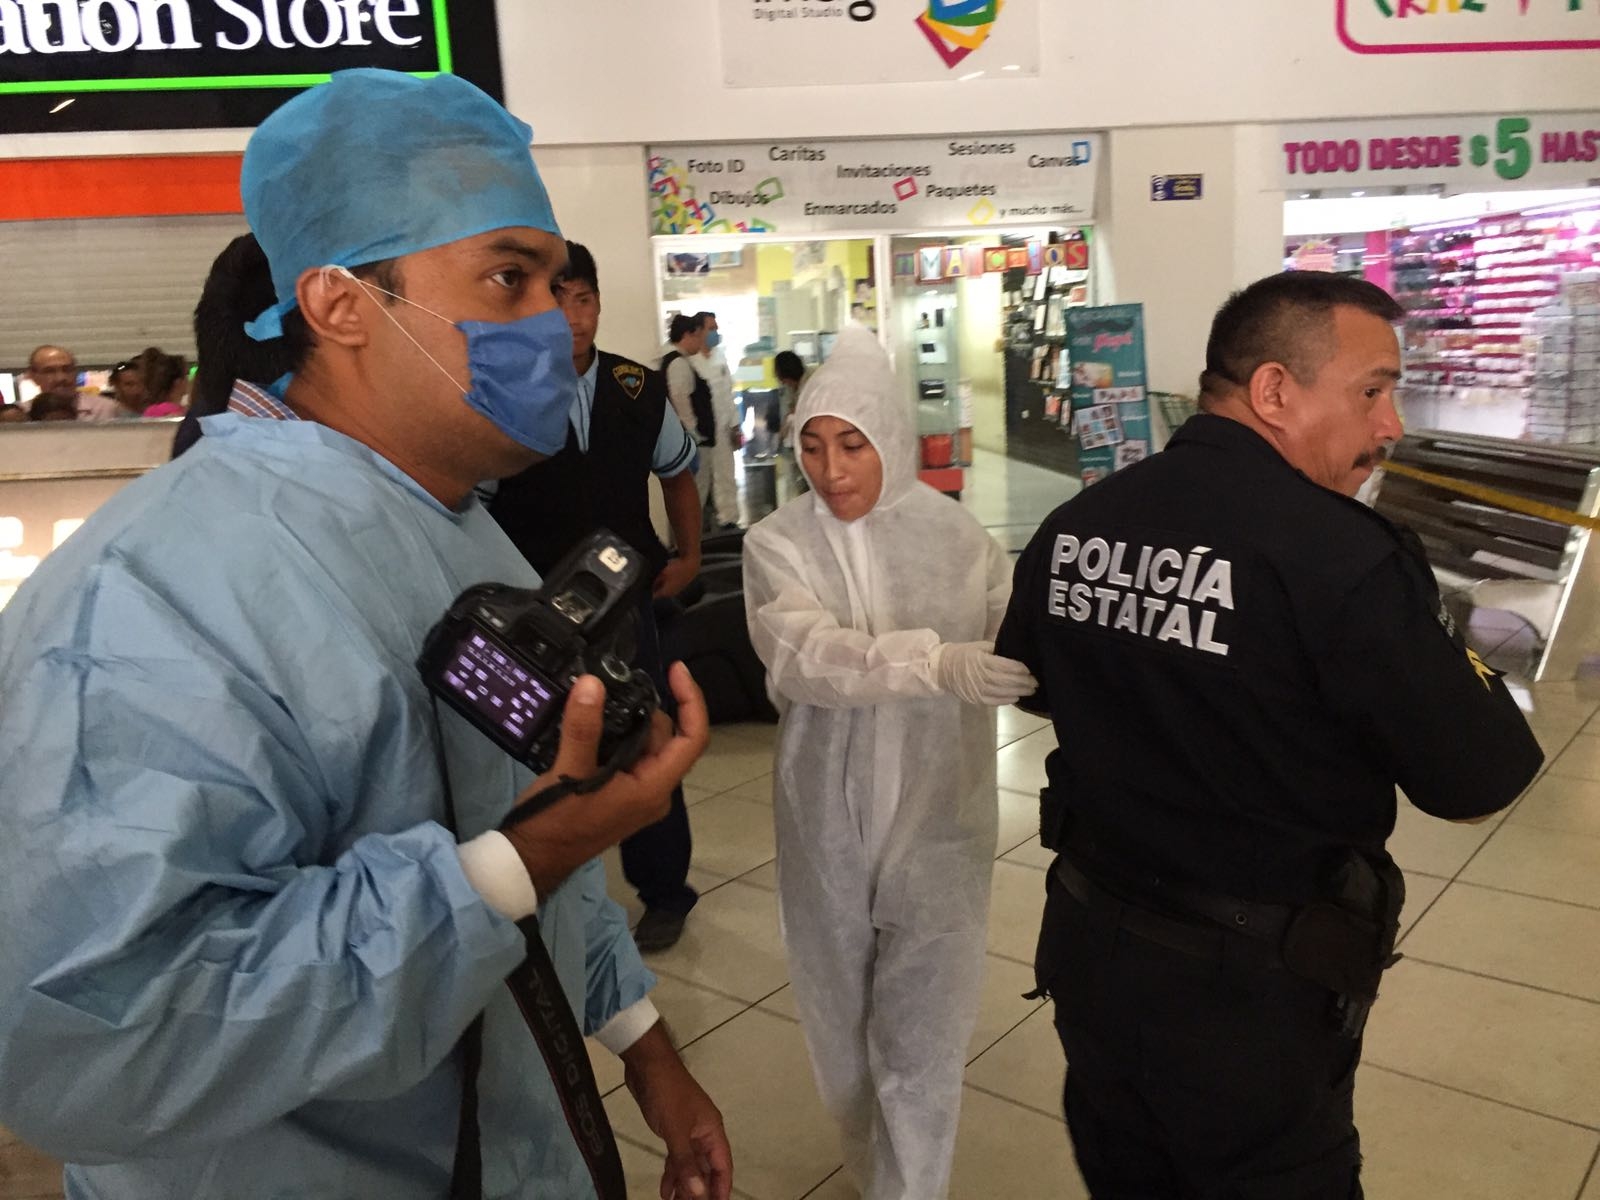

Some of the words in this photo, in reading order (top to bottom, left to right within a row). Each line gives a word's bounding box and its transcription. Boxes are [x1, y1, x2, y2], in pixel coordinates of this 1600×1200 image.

[752, 7, 798, 21] Digital
[801, 7, 843, 18] Studio
[215, 0, 422, 50] Store
[768, 145, 826, 162] Caritas
[948, 141, 1016, 156] Sesiones
[1284, 139, 1361, 174] TODO
[1368, 135, 1462, 170] DESDE
[688, 159, 723, 174] Foto
[728, 158, 745, 174] ID
[1027, 154, 1083, 168] Canvas
[836, 163, 932, 179] Invitaciones
[709, 190, 770, 208] Dibujos
[925, 183, 998, 200] Paquetes
[804, 200, 898, 216] Enmarcados
[999, 208, 1006, 217] y
[1009, 203, 1047, 215] mucho
[1050, 533, 1234, 610] POLICÍA
[1048, 578, 1229, 656] ESTATAL
